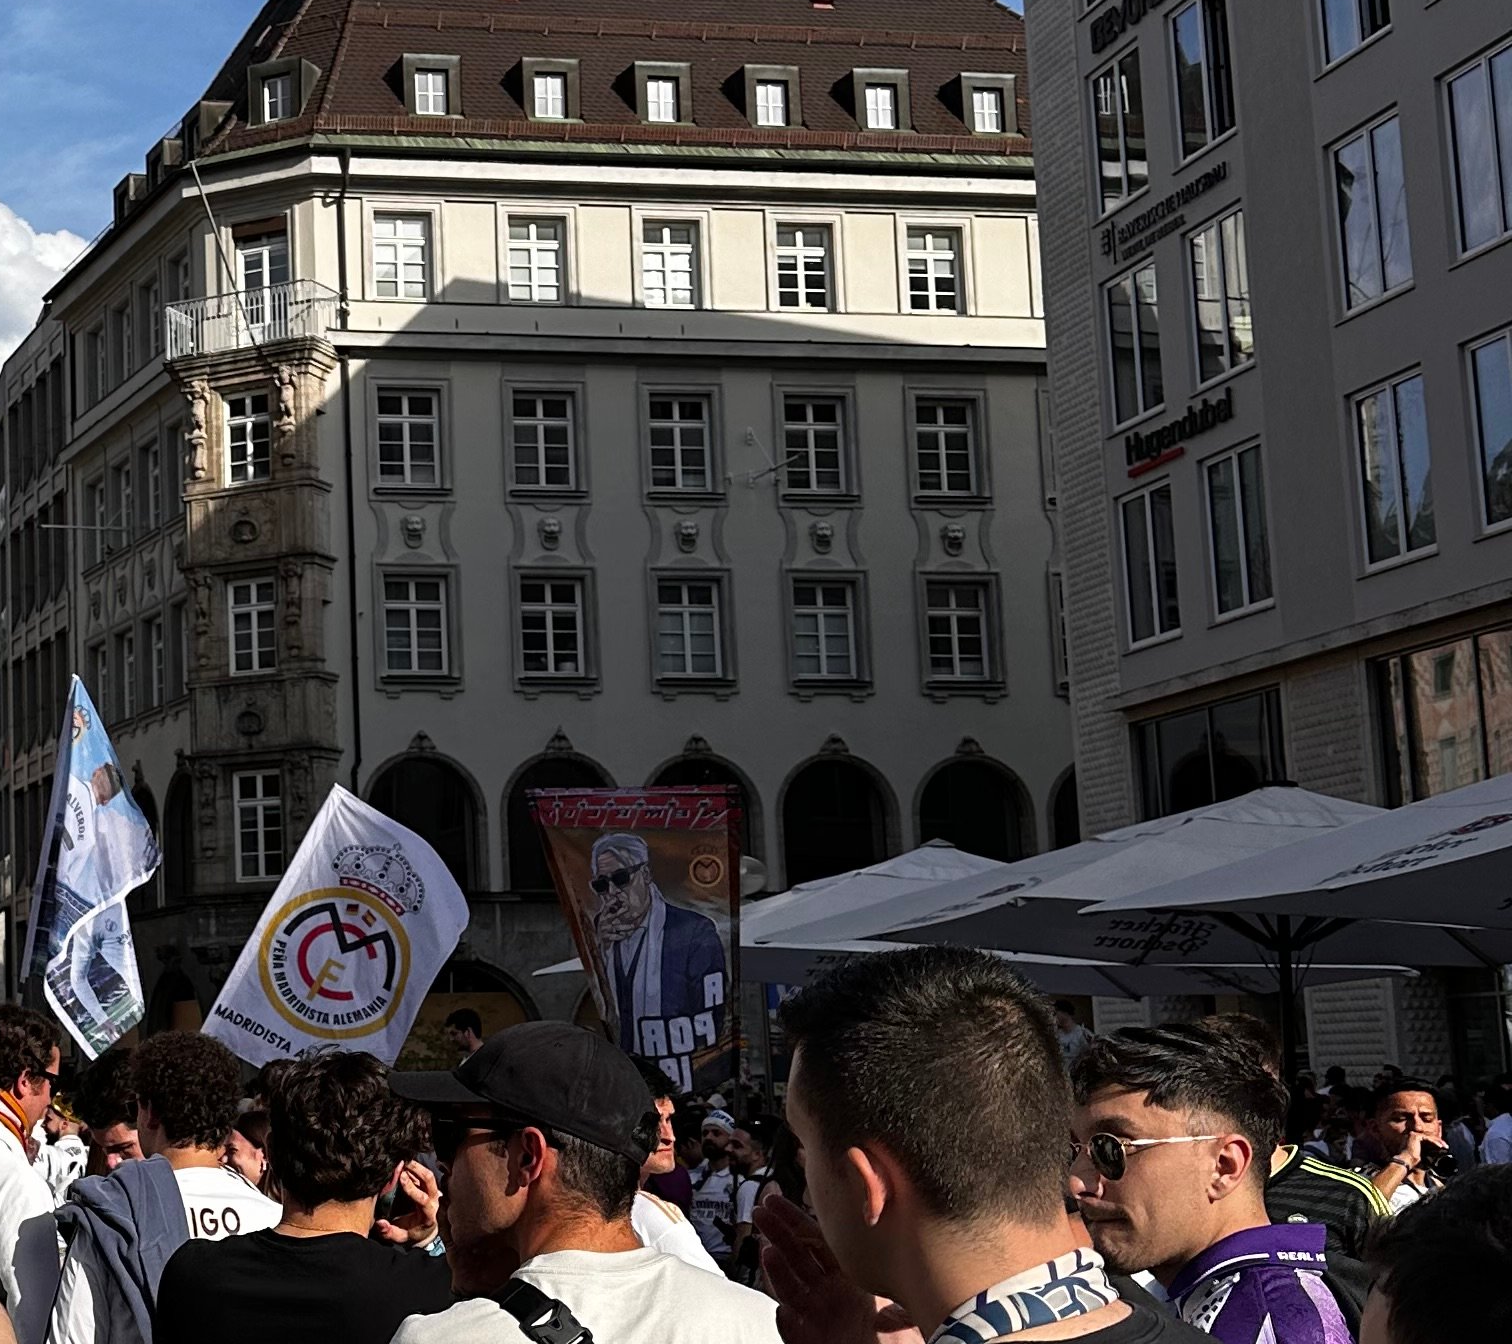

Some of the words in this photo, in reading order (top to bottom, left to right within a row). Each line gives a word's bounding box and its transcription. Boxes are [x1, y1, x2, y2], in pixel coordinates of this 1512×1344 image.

[1125, 386, 1233, 467] Hugendubel
[272, 939, 288, 970] PEÑA
[273, 971, 330, 1026] MADRIDISTA
[332, 995, 388, 1026] ALEMANIA
[214, 1003, 293, 1054] MADRIDISTA
[189, 1206, 241, 1238] IGO
[1276, 1251, 1314, 1262] REAL
